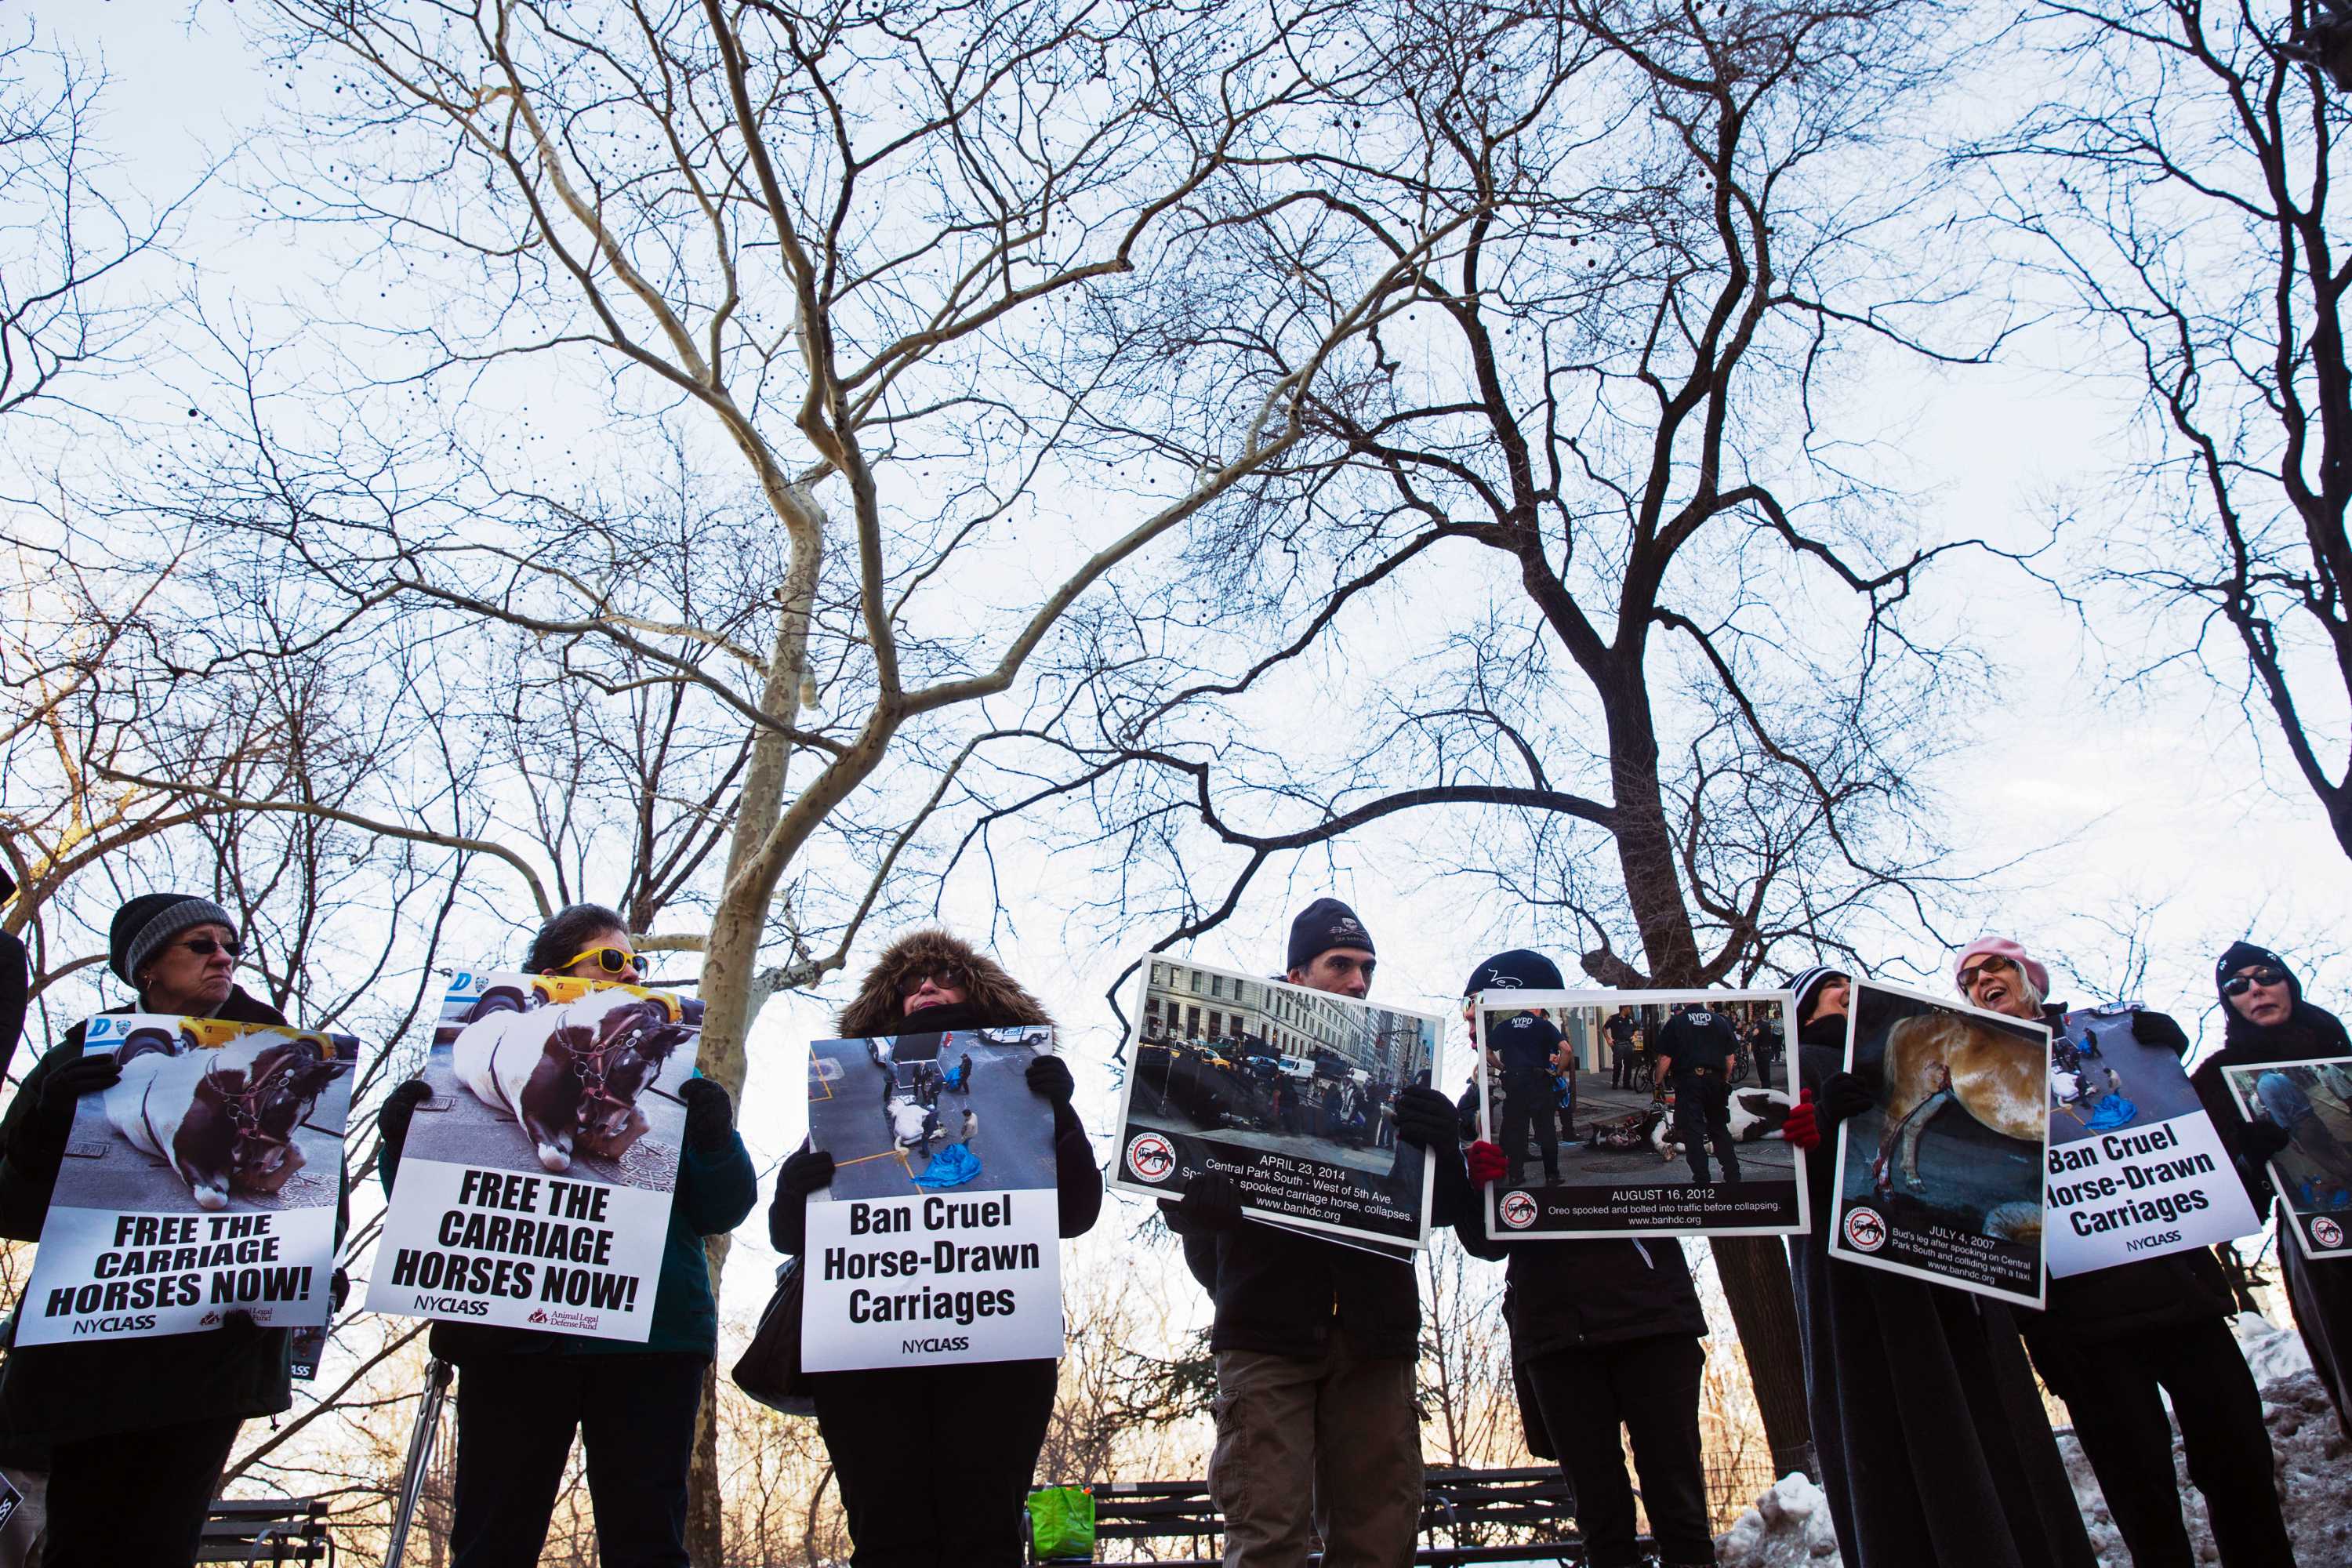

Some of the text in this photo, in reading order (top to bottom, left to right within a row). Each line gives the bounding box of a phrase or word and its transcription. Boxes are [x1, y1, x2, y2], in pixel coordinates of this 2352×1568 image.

[1687, 1013, 1711, 1022] NYPD
[1260, 1155, 1345, 1181] APRIL 23, 2014
[2049, 1123, 2179, 1174] Ban Cruel
[459, 1170, 610, 1222] FREE THE
[1206, 1159, 1244, 1175] Central
[1247, 1167, 1270, 1180] Park
[1273, 1171, 1303, 1186] South
[1313, 1178, 1339, 1194] West
[1341, 1185, 1352, 1196] of
[1354, 1188, 1369, 1200] 5th
[1372, 1192, 1393, 1205] Ave.
[1240, 1178, 1413, 1222] spooked carriage horse, collapses.
[1612, 1189, 1715, 1201] AUGUST 16, 2012
[851, 1194, 1011, 1236] Ban Cruel
[1256, 1196, 1341, 1222] www.banhdc.org
[1572, 1205, 1609, 1216] spooked
[1612, 1205, 1627, 1214] and
[1630, 1204, 1657, 1214] bolted
[1659, 1203, 1675, 1212] into
[1677, 1203, 1701, 1212] traffic
[1704, 1202, 1732, 1211] before
[1734, 1201, 1781, 1212] collapsing.
[1628, 1215, 1701, 1225] www.banhdc.org
[2070, 1189, 2209, 1236] Carriages
[113, 1214, 272, 1247] FREE THE
[438, 1210, 614, 1265] CARRIAGE
[1892, 1227, 1915, 1240] Bud's
[1916, 1234, 1929, 1246] leg
[1930, 1239, 1948, 1249] after
[1951, 1243, 1987, 1260] spooking
[1989, 1254, 1999, 1262] on
[2001, 1255, 2031, 1270] Central
[1929, 1225, 1995, 1250] JULY 4, 2007
[94, 1236, 280, 1279] CARRIAGE
[824, 1240, 1040, 1281] Horse-Drawn
[1892, 1239, 1911, 1250] Park
[1912, 1244, 1936, 1258] South
[1937, 1253, 1952, 1262] and
[1955, 1255, 1988, 1272] colliding
[1990, 1264, 2006, 1276] with
[1928, 1261, 1995, 1285] www.banhdc.org
[45, 1266, 313, 1317] HORSES NOW!
[391, 1248, 640, 1312] HORSES NOW!
[550, 1318, 597, 1330] Defense Fund
[552, 1311, 599, 1323] Animal Legal
[849, 1286, 1015, 1326] Carriages
